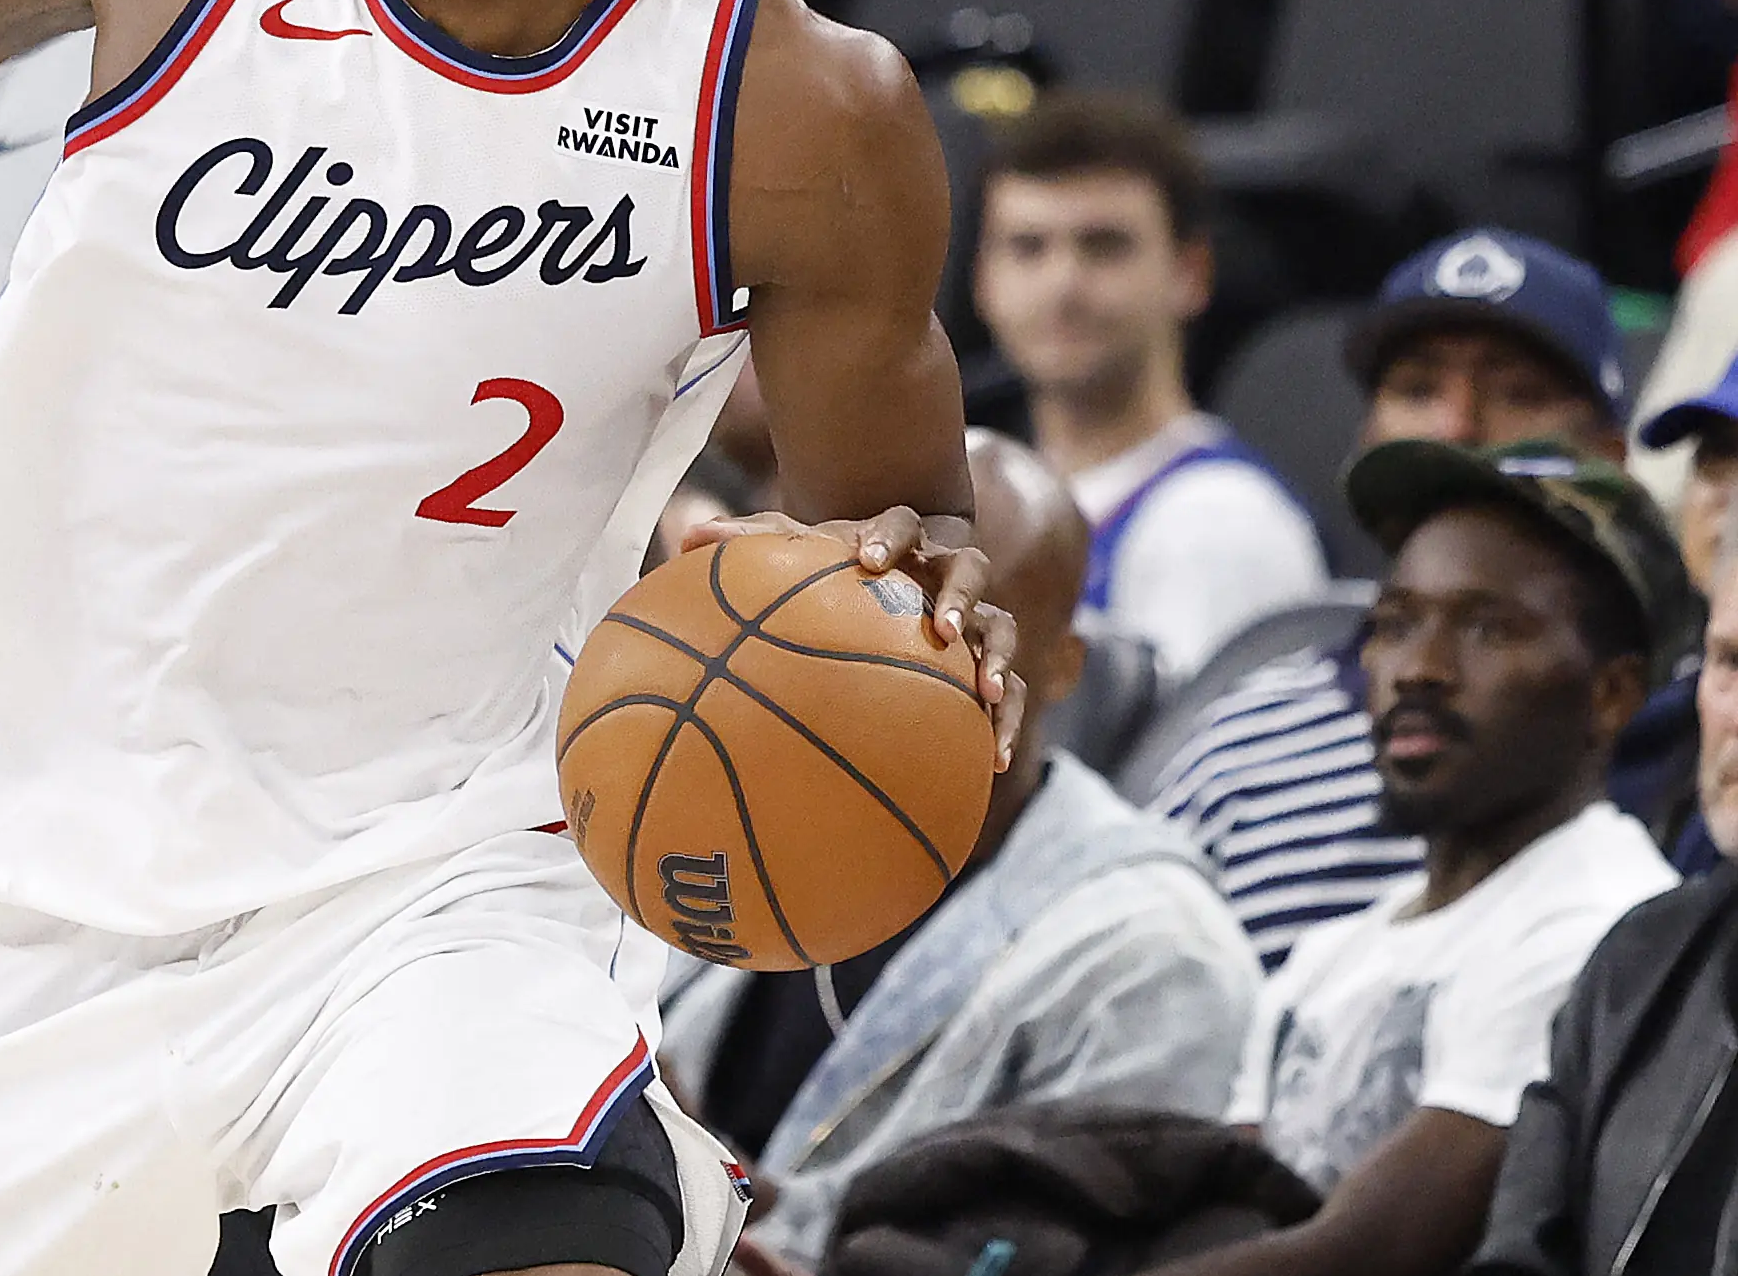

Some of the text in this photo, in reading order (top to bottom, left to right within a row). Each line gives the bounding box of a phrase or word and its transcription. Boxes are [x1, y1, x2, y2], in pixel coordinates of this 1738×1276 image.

[557, 126, 680, 169] RWANDA
[584, 107, 659, 139] VISIT
[156, 137, 648, 315] Clippers
[415, 377, 565, 527] 2
